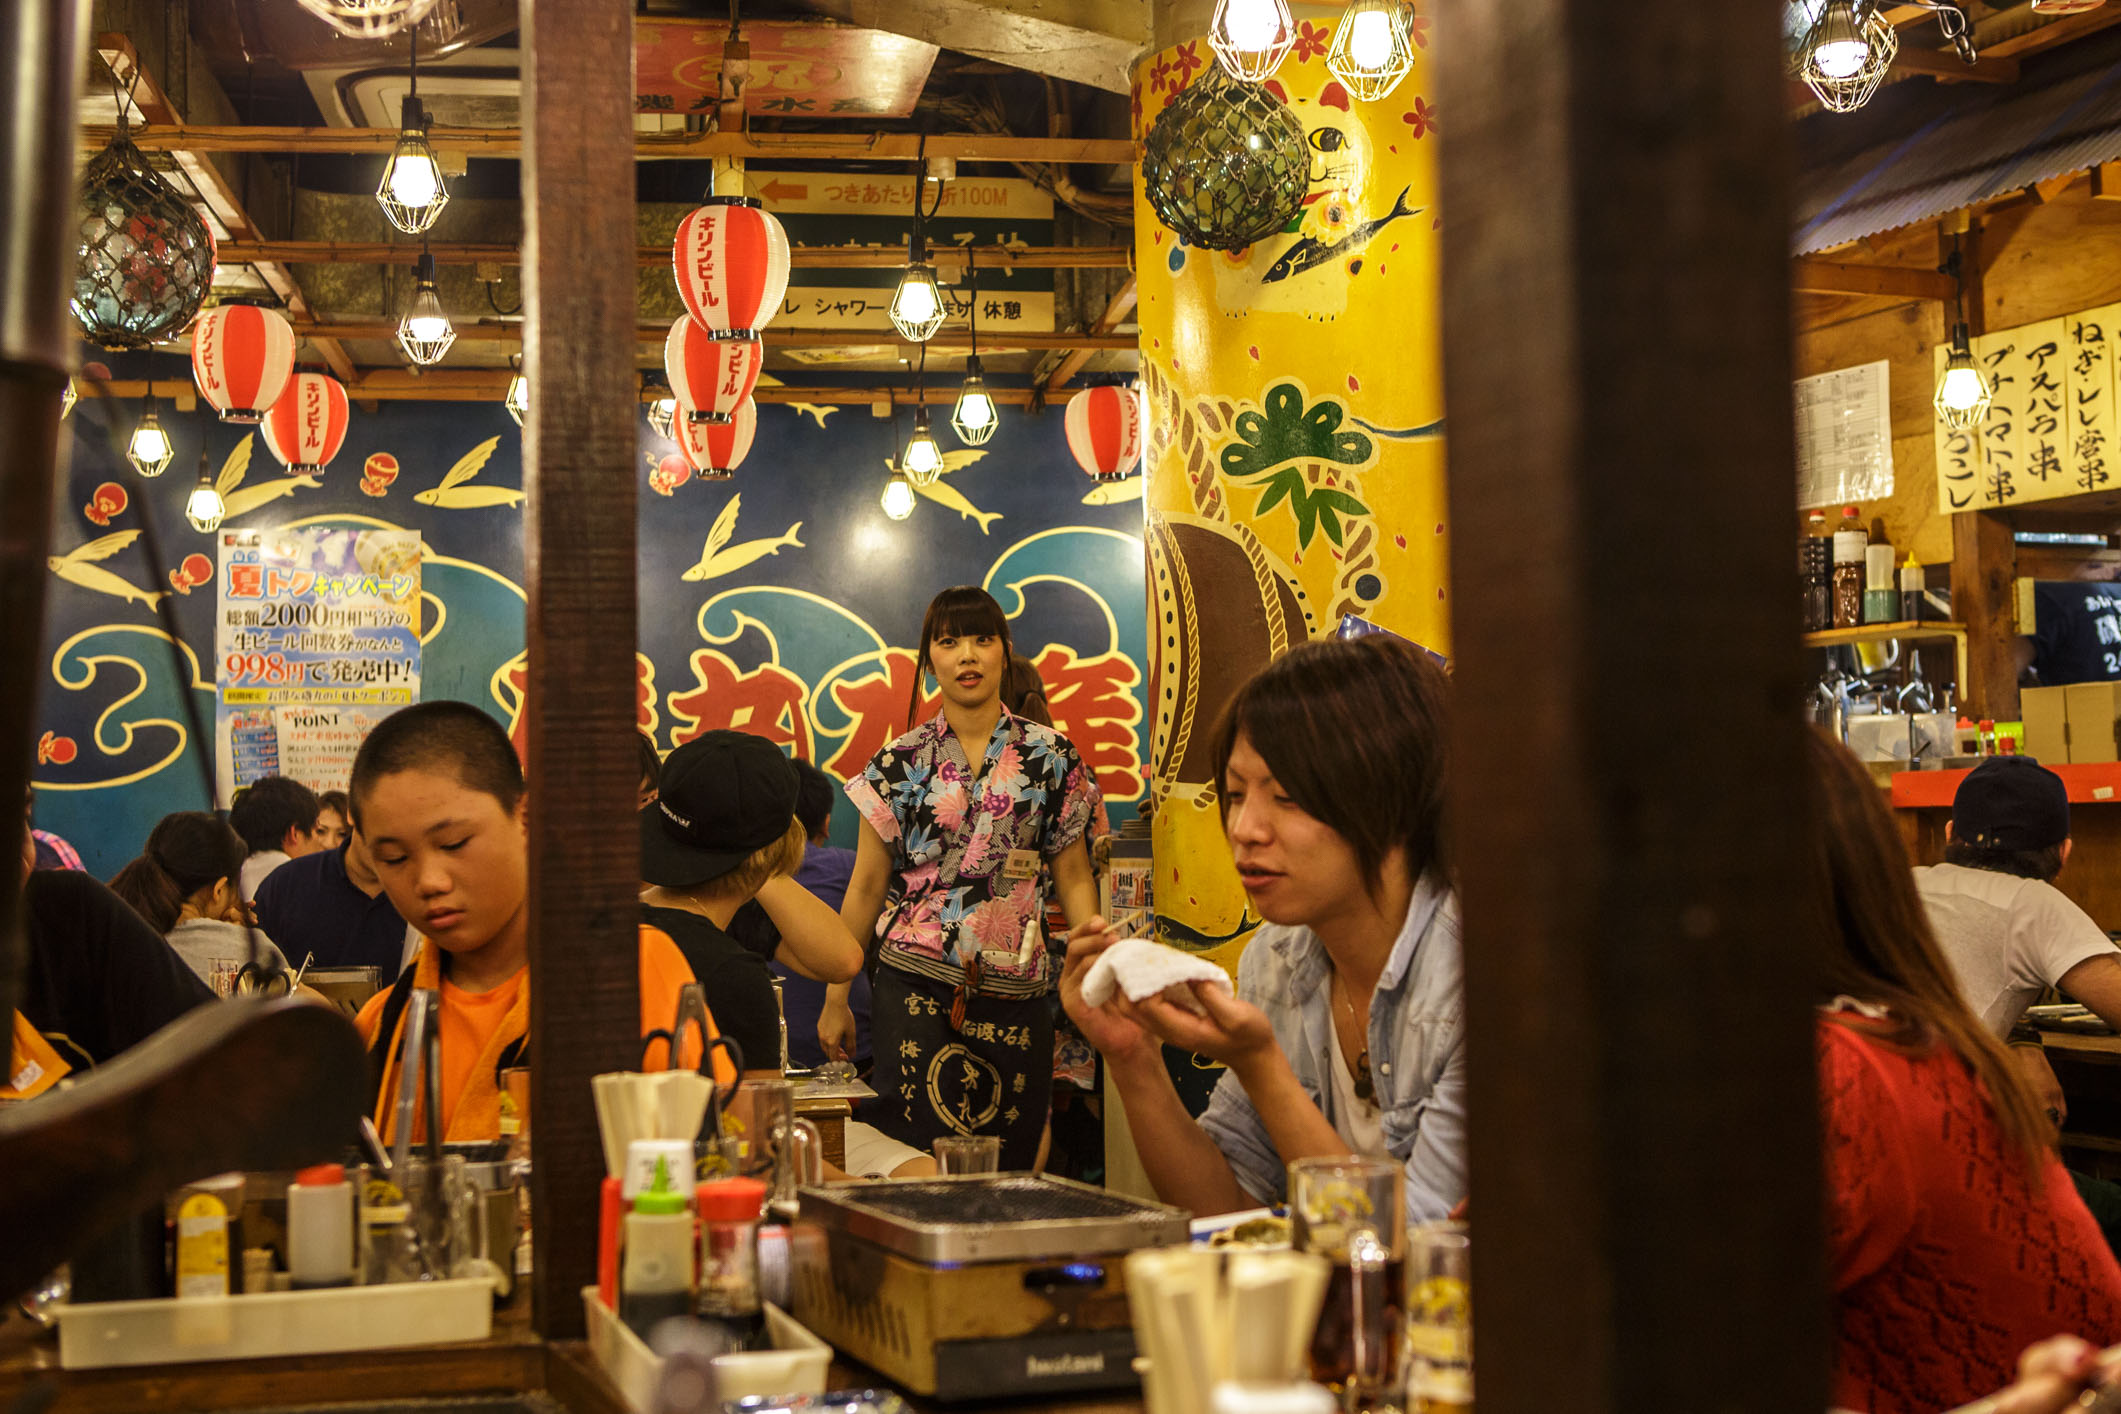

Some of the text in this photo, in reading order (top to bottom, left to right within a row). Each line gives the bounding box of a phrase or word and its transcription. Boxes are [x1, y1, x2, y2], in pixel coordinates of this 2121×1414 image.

[697, 215, 720, 309] キリンビール
[815, 299, 886, 317] シャワー
[983, 300, 1022, 320] 休憩
[305, 381, 321, 449] キリンビール
[294, 714, 340, 728] POINT
